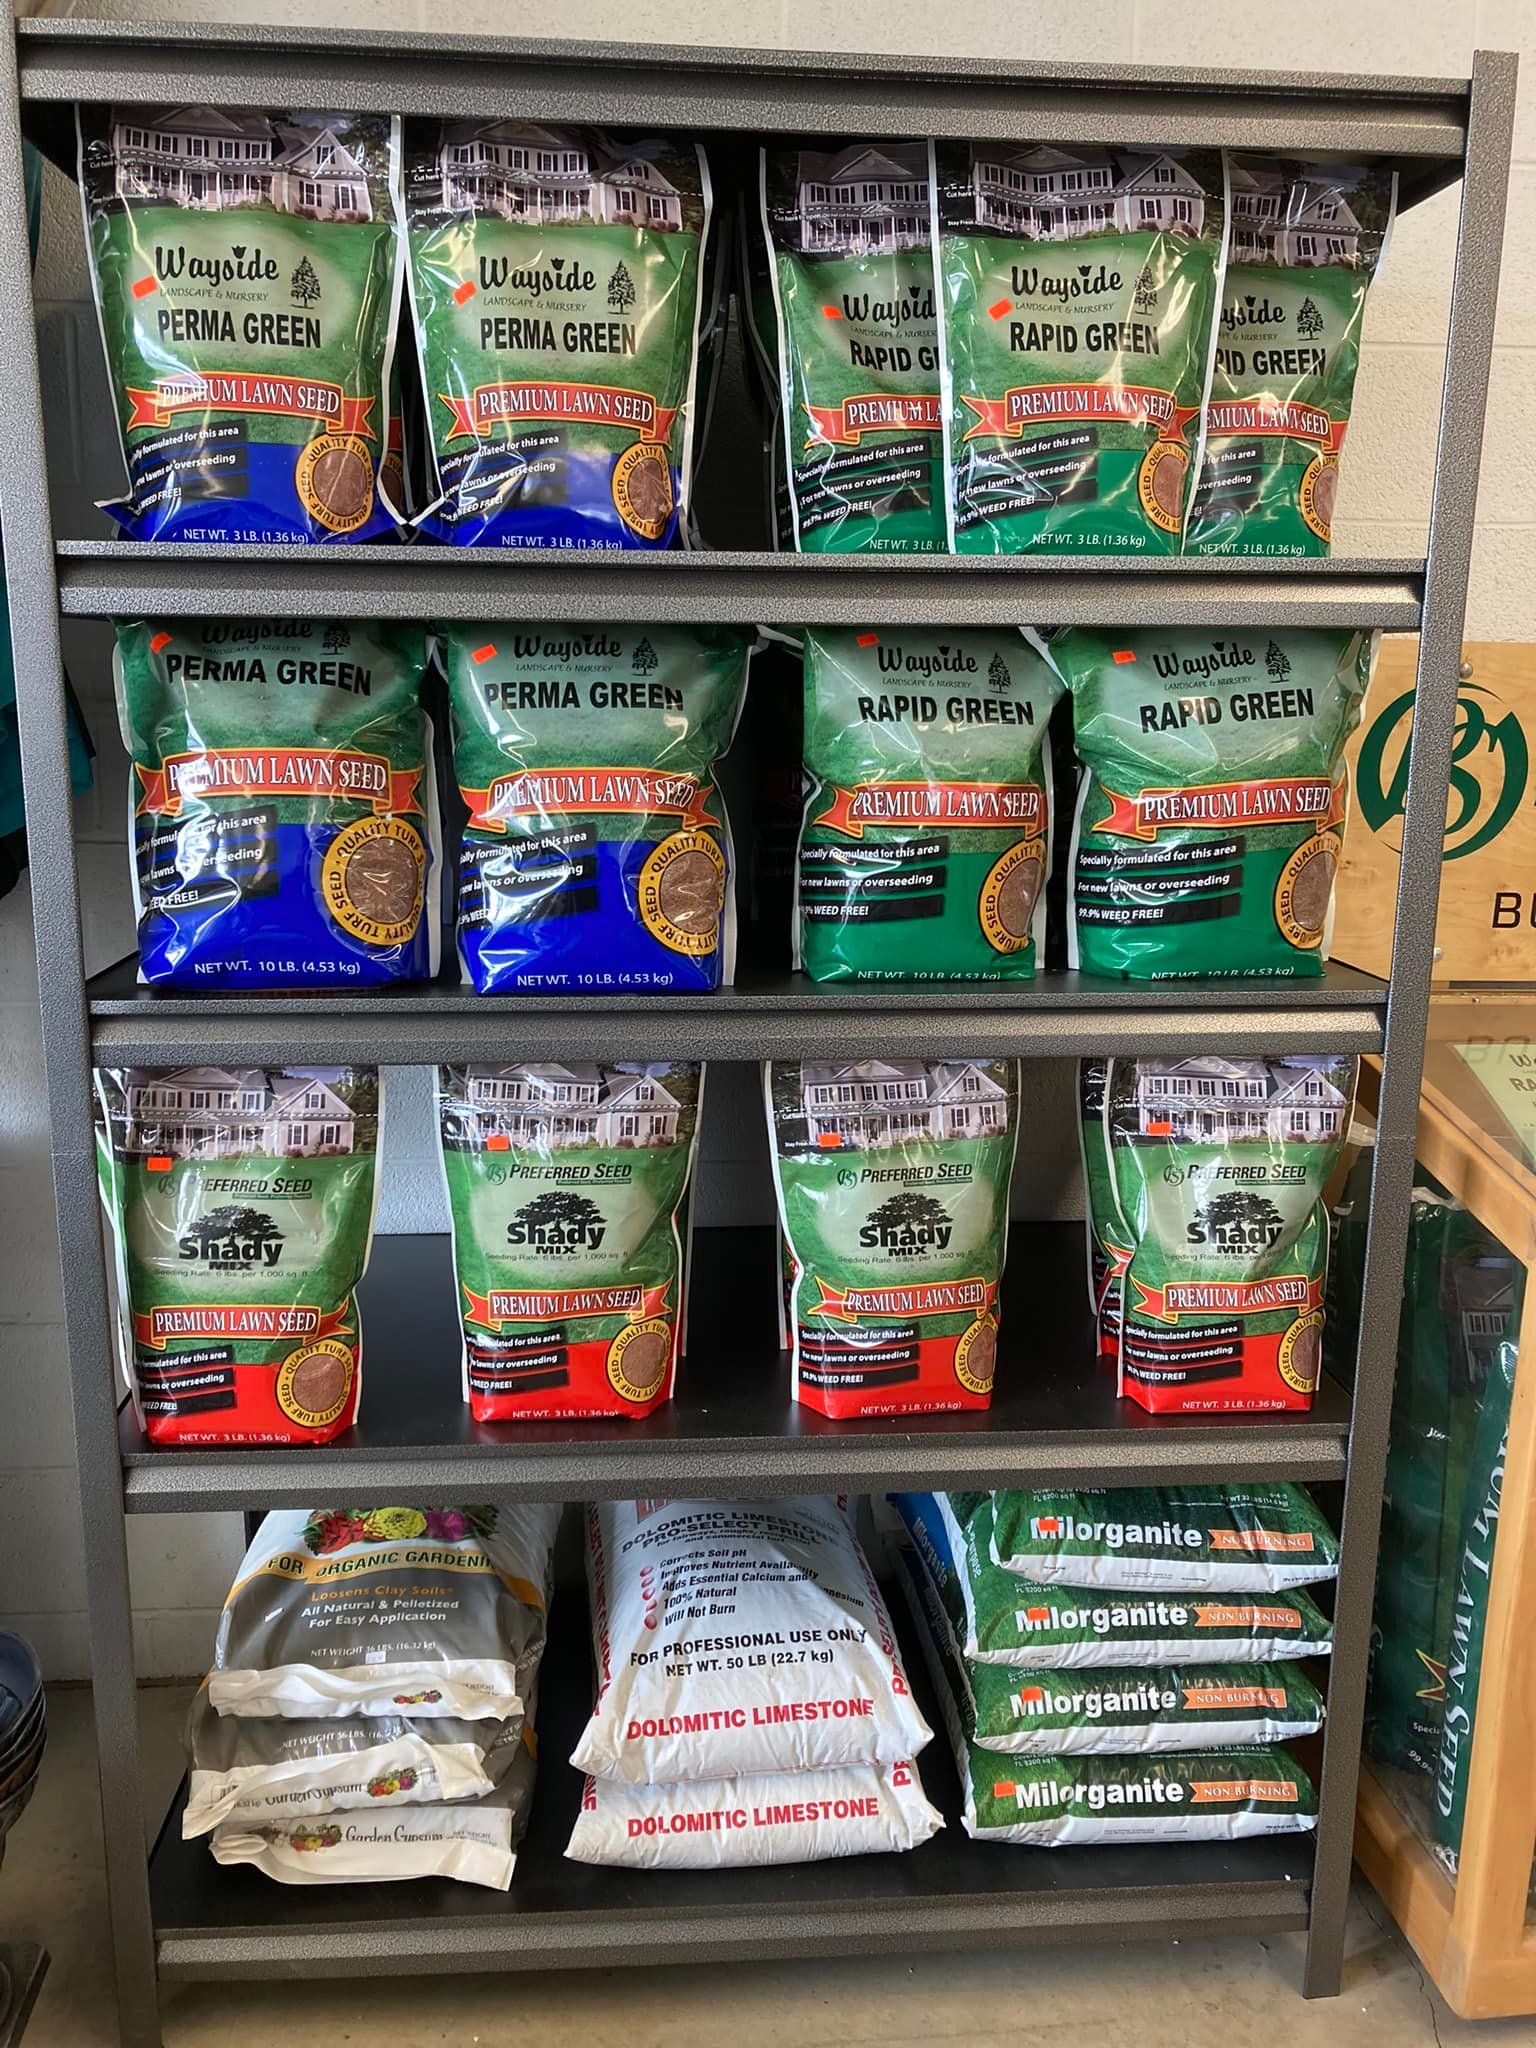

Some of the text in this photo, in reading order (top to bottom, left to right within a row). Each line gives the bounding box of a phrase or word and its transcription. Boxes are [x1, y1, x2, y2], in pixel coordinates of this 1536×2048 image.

[156, 246, 279, 286] Wayside
[480, 256, 596, 297] Wayside
[1012, 264, 1123, 304] Wayside
[158, 309, 321, 348] PERMA GREEN
[480, 318, 636, 354] PERMA GREEN
[1010, 322, 1160, 354] RAPID GREEN
[851, 340, 911, 372] RAPID
[1252, 348, 1325, 376] GREEN
[242, 382, 294, 406] LAWN
[297, 388, 339, 414] SEED
[479, 390, 652, 422] PREMIUM LAWN SEED
[1011, 391, 1174, 421] PREMIUM LAWN SEED
[848, 401, 922, 426] PREMIUM
[1261, 408, 1328, 436] LAWN SEED
[202, 620, 312, 644] Wayside
[514, 634, 623, 664] Wayside
[878, 646, 978, 677] Wayside
[1153, 641, 1256, 679] Wayside
[166, 654, 371, 696] PERMA GREEN
[484, 682, 683, 711] PERMA GREEN
[858, 696, 1034, 725] RAPID GREEN
[1140, 688, 1314, 734] RAPID GREEN
[169, 757, 386, 792] PMIUM LAWN SEED
[494, 775, 695, 808] PREMIUM LAWN SEED
[852, 791, 1038, 818] PREMIUM LAWN SEED
[1144, 786, 1331, 821] PREMIUM LAWN SEED
[1080, 844, 1237, 866] Specially formulated for this area
[1078, 873, 1230, 894] For new lawns or overseeding
[1078, 908, 1163, 920] 99.9% WEED FREE!
[195, 960, 360, 974] NET WT. 10 LB. (4.53 kg)
[272, 1178, 312, 1192] SEED
[509, 1163, 632, 1180] PREFERRED SEED
[861, 1166, 934, 1183] PREFERRED
[938, 1163, 972, 1177] SEED
[1188, 1164, 1307, 1179] PFERRED SEED
[507, 1221, 606, 1249] Shady
[859, 1224, 952, 1250] Shady
[1188, 1222, 1283, 1250] Shady
[179, 1234, 283, 1267] Shady
[536, 1246, 576, 1254] MIX
[888, 1246, 927, 1256] MIX
[1216, 1245, 1259, 1254] MIX
[209, 1261, 253, 1270] MIX
[492, 1289, 640, 1316] PREMIUM LAWN SEED
[848, 1283, 984, 1312] PREMIUM LAWN SEED
[1168, 1280, 1307, 1308] PREMIUM LAWN SEED
[155, 1311, 316, 1332] PREMIUM LAWN SEED
[622, 1511, 728, 1553] DOLOMITIC
[642, 1520, 760, 1549] PRO-SELECT
[766, 1523, 821, 1544] PRILL
[268, 1556, 304, 1574] FOR
[315, 1552, 399, 1577] ORGANIC
[660, 1548, 747, 1568] Corrects Soil pH
[661, 1560, 756, 1580] Improves Nutrient
[311, 1586, 372, 1602] Loosens
[374, 1585, 408, 1596] Clay
[662, 1572, 808, 1592] Adds Essential Calcium and
[301, 1600, 459, 1618] All Natural & Pelletized
[664, 1587, 736, 1610] 100% Natural
[309, 1612, 447, 1628] For Easy Application
[664, 1604, 736, 1627] Will Not Burn
[1208, 1612, 1294, 1622] NON BURNING
[1448, 1538, 1490, 1694] LAWN
[630, 1628, 867, 1666] FOR PROFESSIONAL USE ONLY
[666, 1650, 834, 1678] NET WT. 50 LB (22.7 kg)
[1196, 1695, 1222, 1703] NON
[627, 1698, 874, 1740] DOLOMITIC LIMESTONE
[1438, 1705, 1470, 1817] SEED
[1015, 1778, 1184, 1809] Milorganite
[1204, 1786, 1290, 1796] NON BURNING
[628, 1797, 879, 1837] DOLOMITIC LIMESTONE
